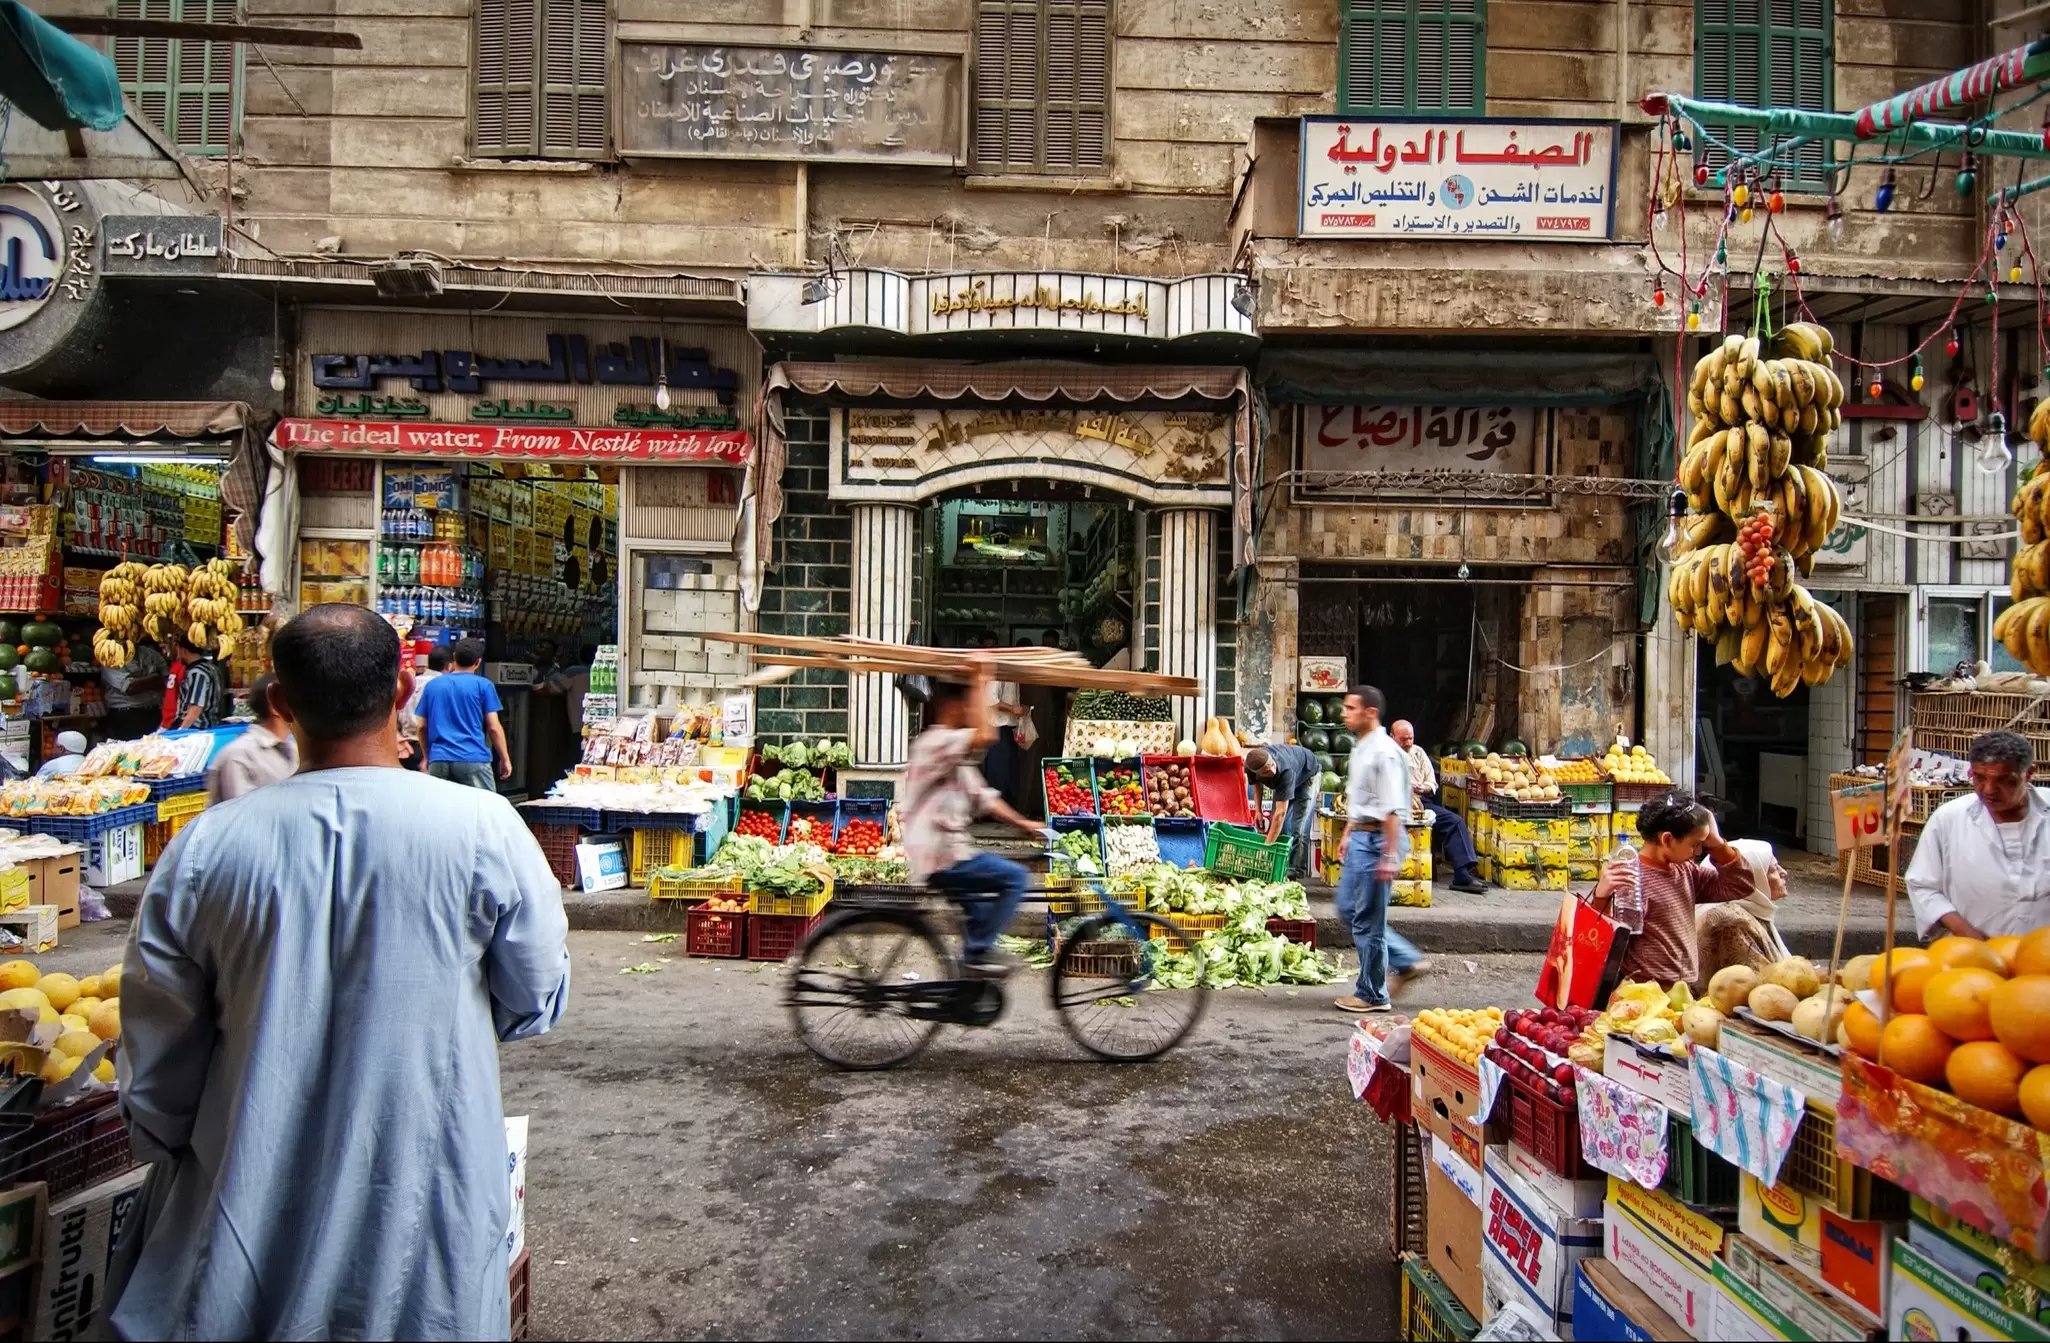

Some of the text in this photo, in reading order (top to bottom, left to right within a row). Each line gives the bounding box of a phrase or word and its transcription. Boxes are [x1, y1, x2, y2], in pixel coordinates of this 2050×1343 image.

[857, 54, 938, 83] كتور
[1327, 125, 1593, 175] الصفا الدولية
[1361, 182, 1436, 209] والتخليص
[1477, 182, 1540, 207] الشحن
[1544, 183, 1605, 205] لخدمات
[1461, 215, 1521, 234] والتصدير
[109, 232, 218, 261] سلطان ماركت
[1019, 285, 1053, 312] الله
[311, 333, 739, 406] بقالة السويس
[471, 399, 573, 421] معلبات
[284, 422, 334, 444] The
[341, 424, 400, 446] ideal
[407, 429, 484, 448] water.
[492, 427, 562, 450] From
[570, 430, 641, 453] Nestlé
[647, 433, 701, 454] with
[422, 480, 447, 493] OMO
[1640, 1200, 1657, 1221] Fresh
[1657, 1212, 1674, 1233] Fruits
[1682, 1231, 1712, 1261] Vegetabl
[1487, 1213, 1542, 1288] APPLE
[1650, 1257, 1682, 1293] PRODUCE
[1971, 1299, 2015, 1333] TURKISH
